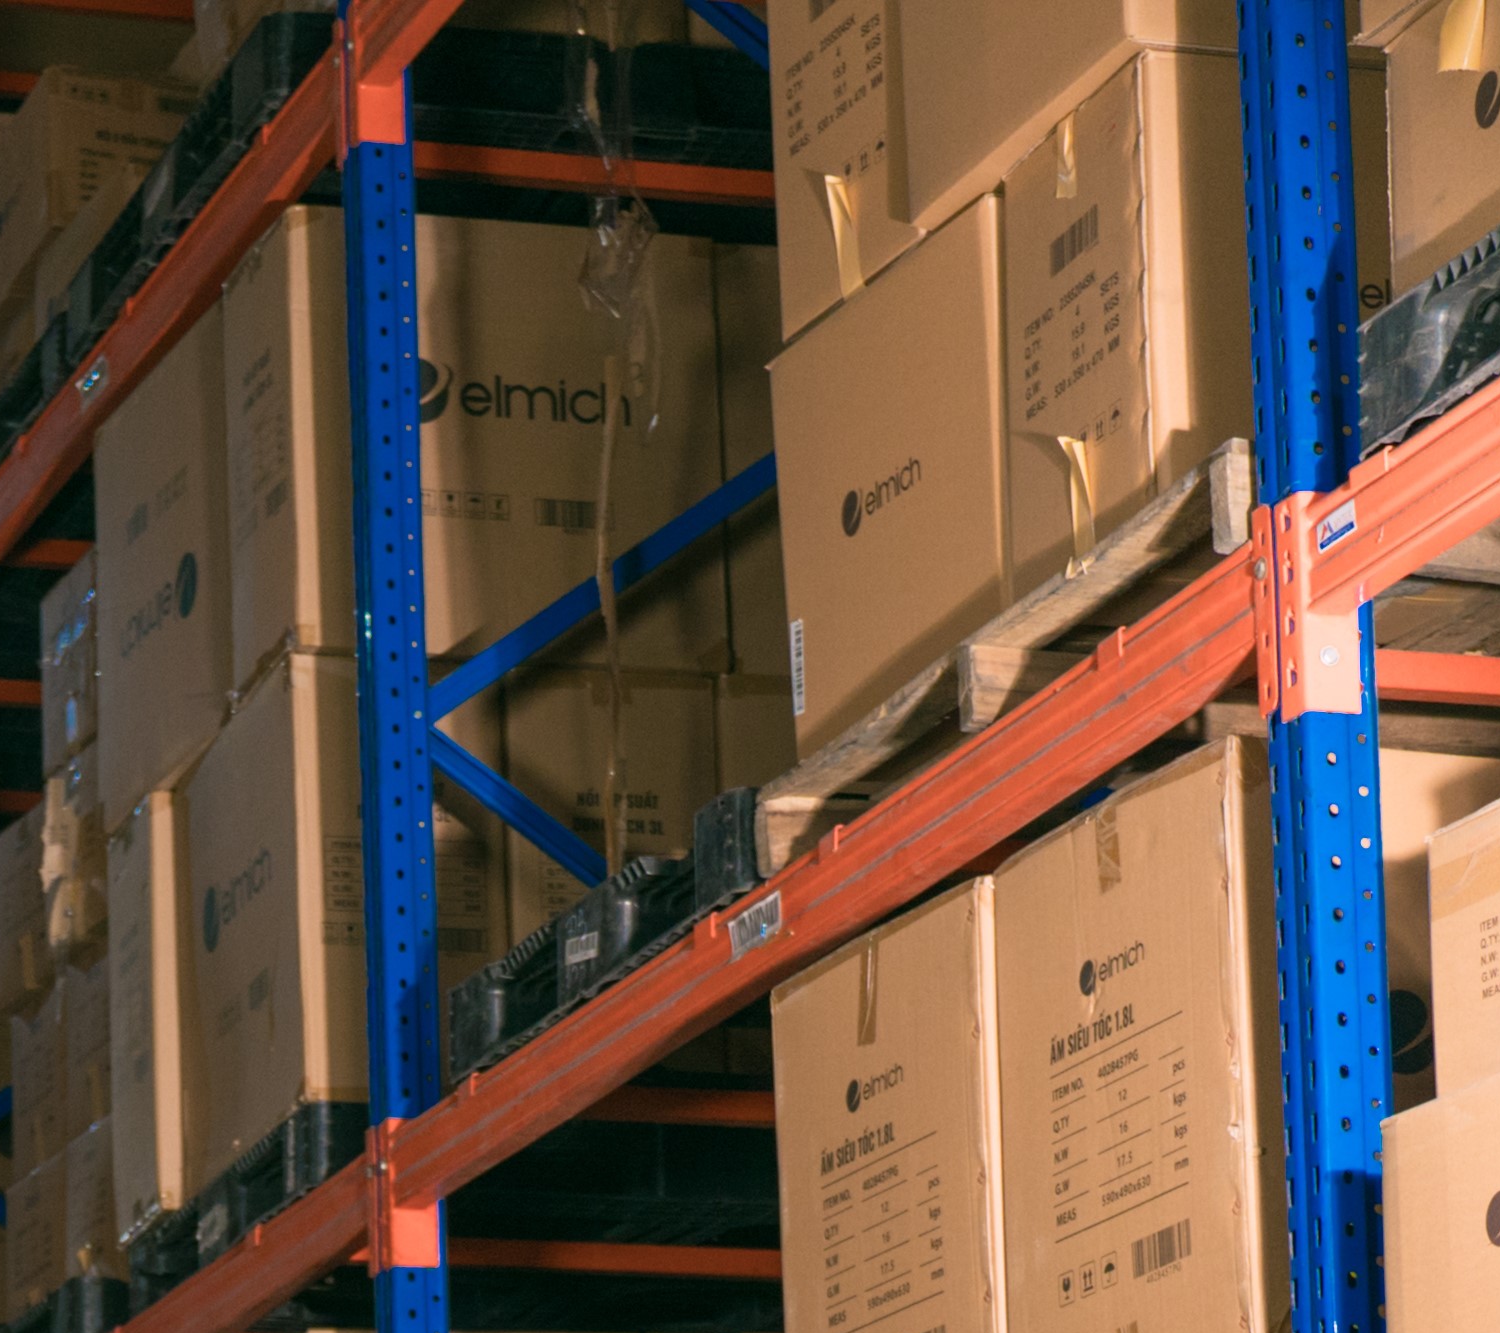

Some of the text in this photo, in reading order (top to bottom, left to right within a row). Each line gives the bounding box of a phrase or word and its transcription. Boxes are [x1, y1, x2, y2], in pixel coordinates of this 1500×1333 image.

[461, 374, 631, 427] elmich
[864, 457, 921, 516] elmich
[1098, 940, 1145, 982] elmich
[1050, 1003, 1135, 1066] ẤM SIÊU TỐC 1.8L
[863, 1063, 904, 1101] elmich
[1052, 1048, 1139, 1102] ITEM NO. 4028457PG
[1053, 1059, 1186, 1134] Q.TY 12 pcs
[821, 1122, 895, 1176] ẤM SIÊU TỐC 1.8L
[1054, 1091, 1187, 1164] N.W 16 kgs
[1055, 1124, 1188, 1195] G.W 17.5 kgs
[1056, 1157, 1189, 1227] MEAS 590x490x630 mm
